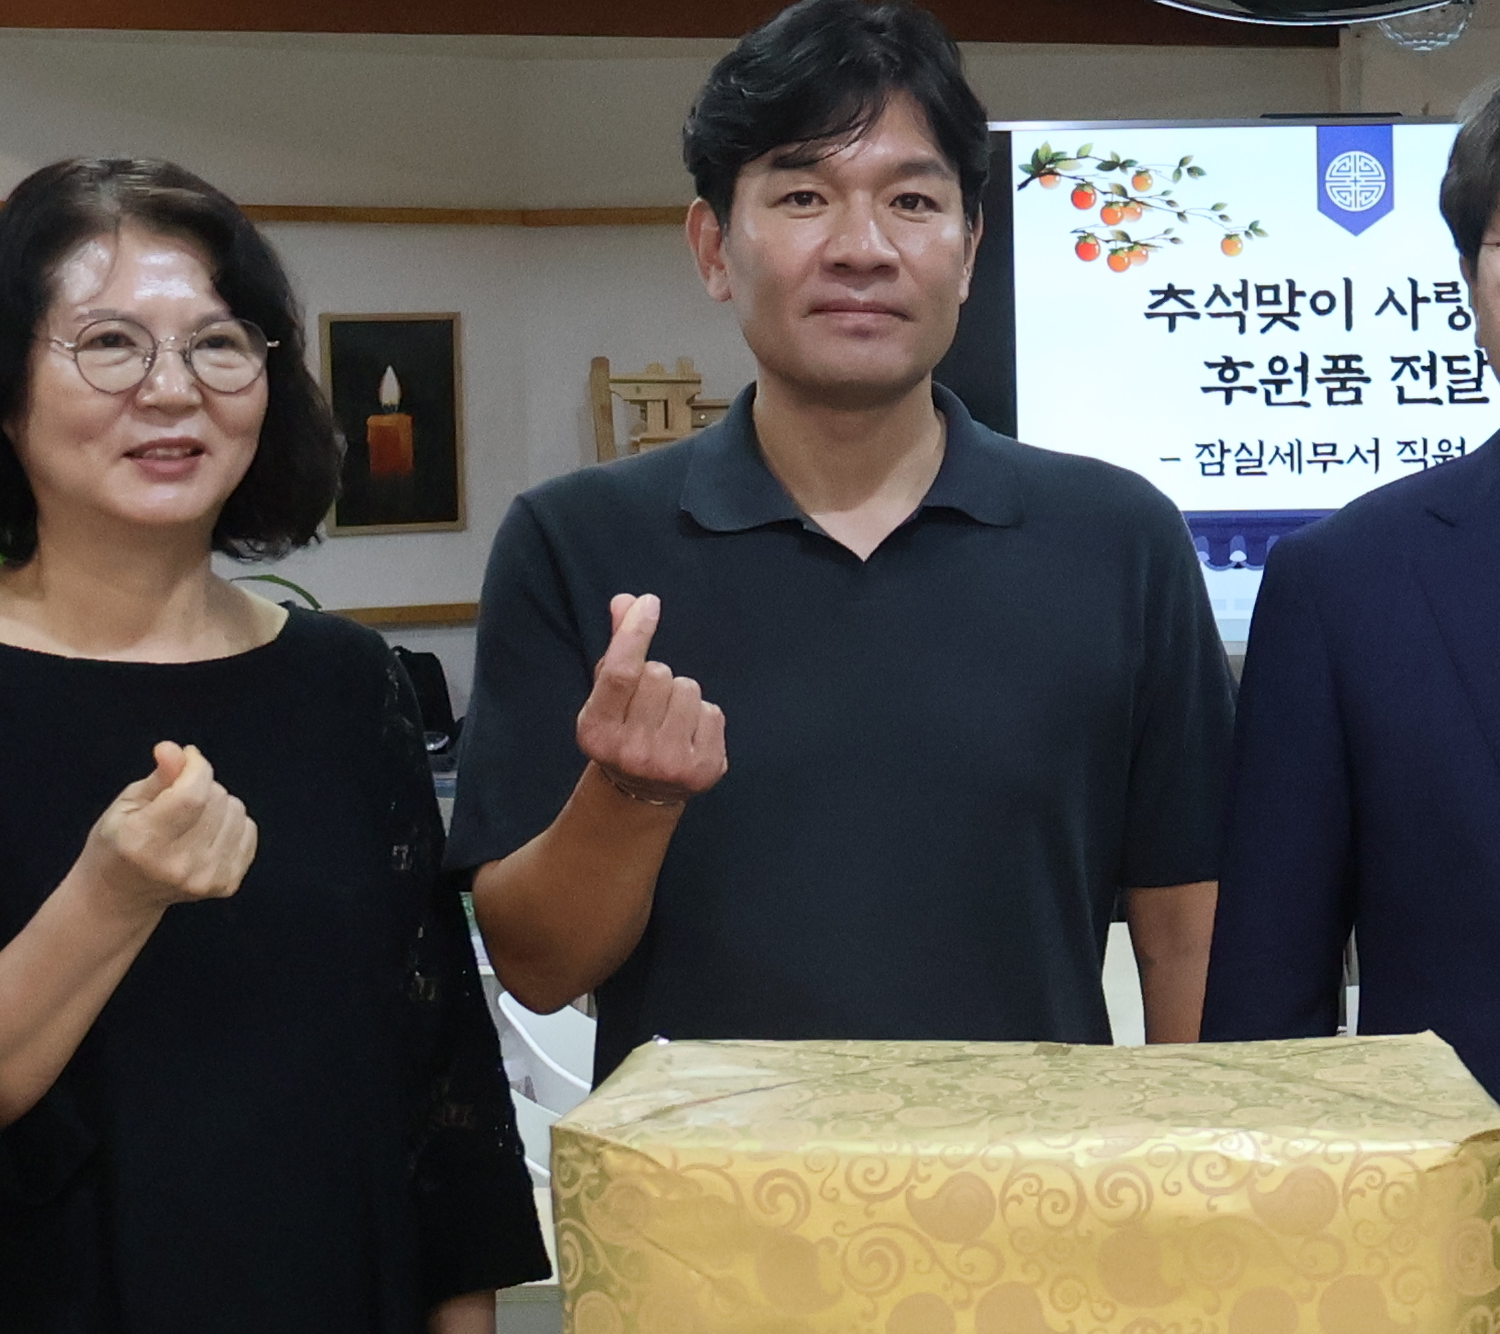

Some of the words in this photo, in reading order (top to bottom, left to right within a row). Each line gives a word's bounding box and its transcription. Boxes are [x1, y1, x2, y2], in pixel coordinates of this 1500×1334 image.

[1144, 277, 1354, 335] 추석맞이
[1200, 351, 1372, 408] 후원품
[1390, 349, 1491, 406] 전달
[1195, 437, 1380, 477] 잠실세무서
